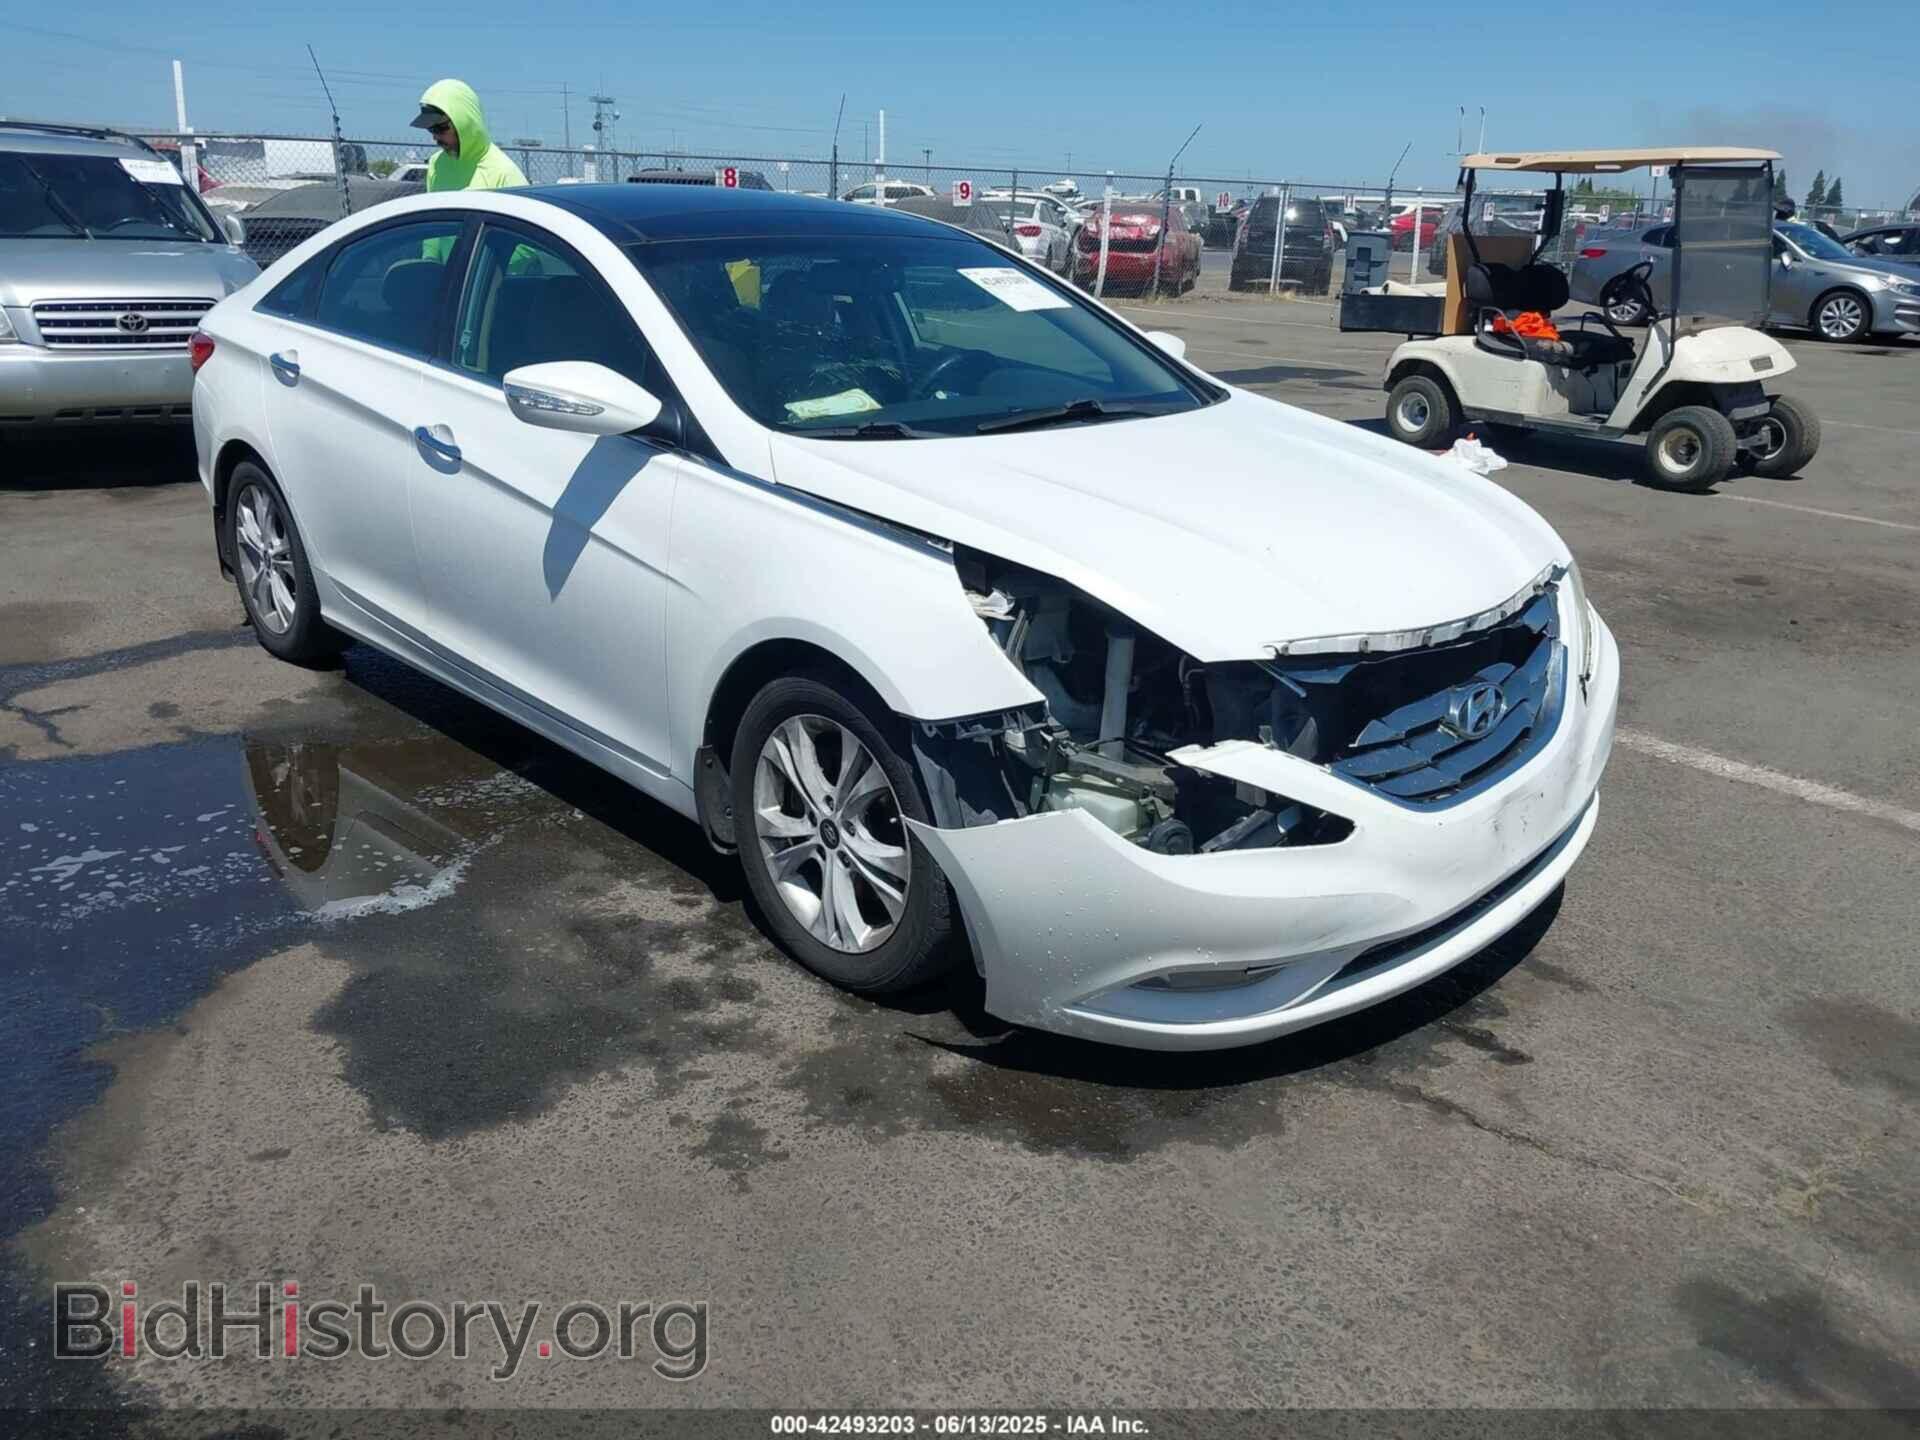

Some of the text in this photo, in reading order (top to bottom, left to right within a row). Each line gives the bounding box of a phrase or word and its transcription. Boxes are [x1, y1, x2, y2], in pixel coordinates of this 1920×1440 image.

[724, 167, 737, 188] 8
[960, 182, 970, 200] 9
[1218, 191, 1229, 207] 10
